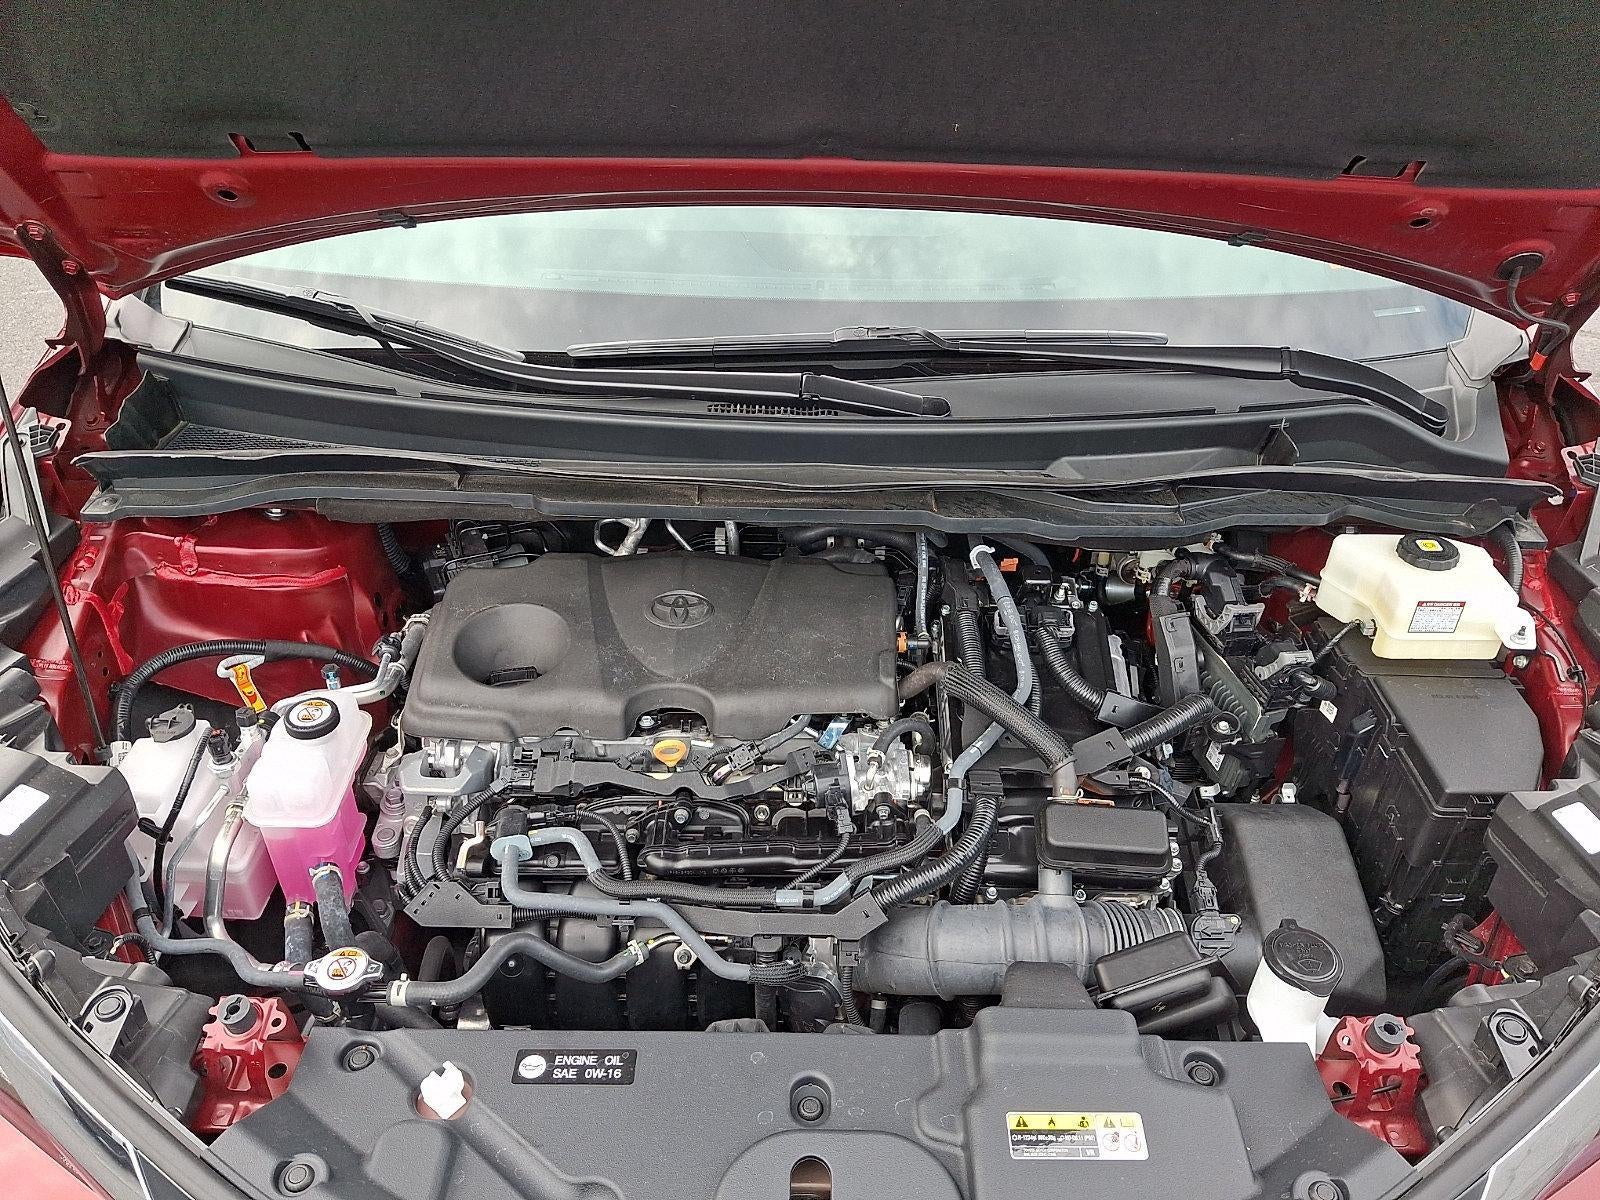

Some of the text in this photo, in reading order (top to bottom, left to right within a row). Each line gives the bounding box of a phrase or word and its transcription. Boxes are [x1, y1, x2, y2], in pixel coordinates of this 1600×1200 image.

[554, 1055, 624, 1066] ENGINE OIL
[552, 1068, 622, 1079] SAE 0W-16
